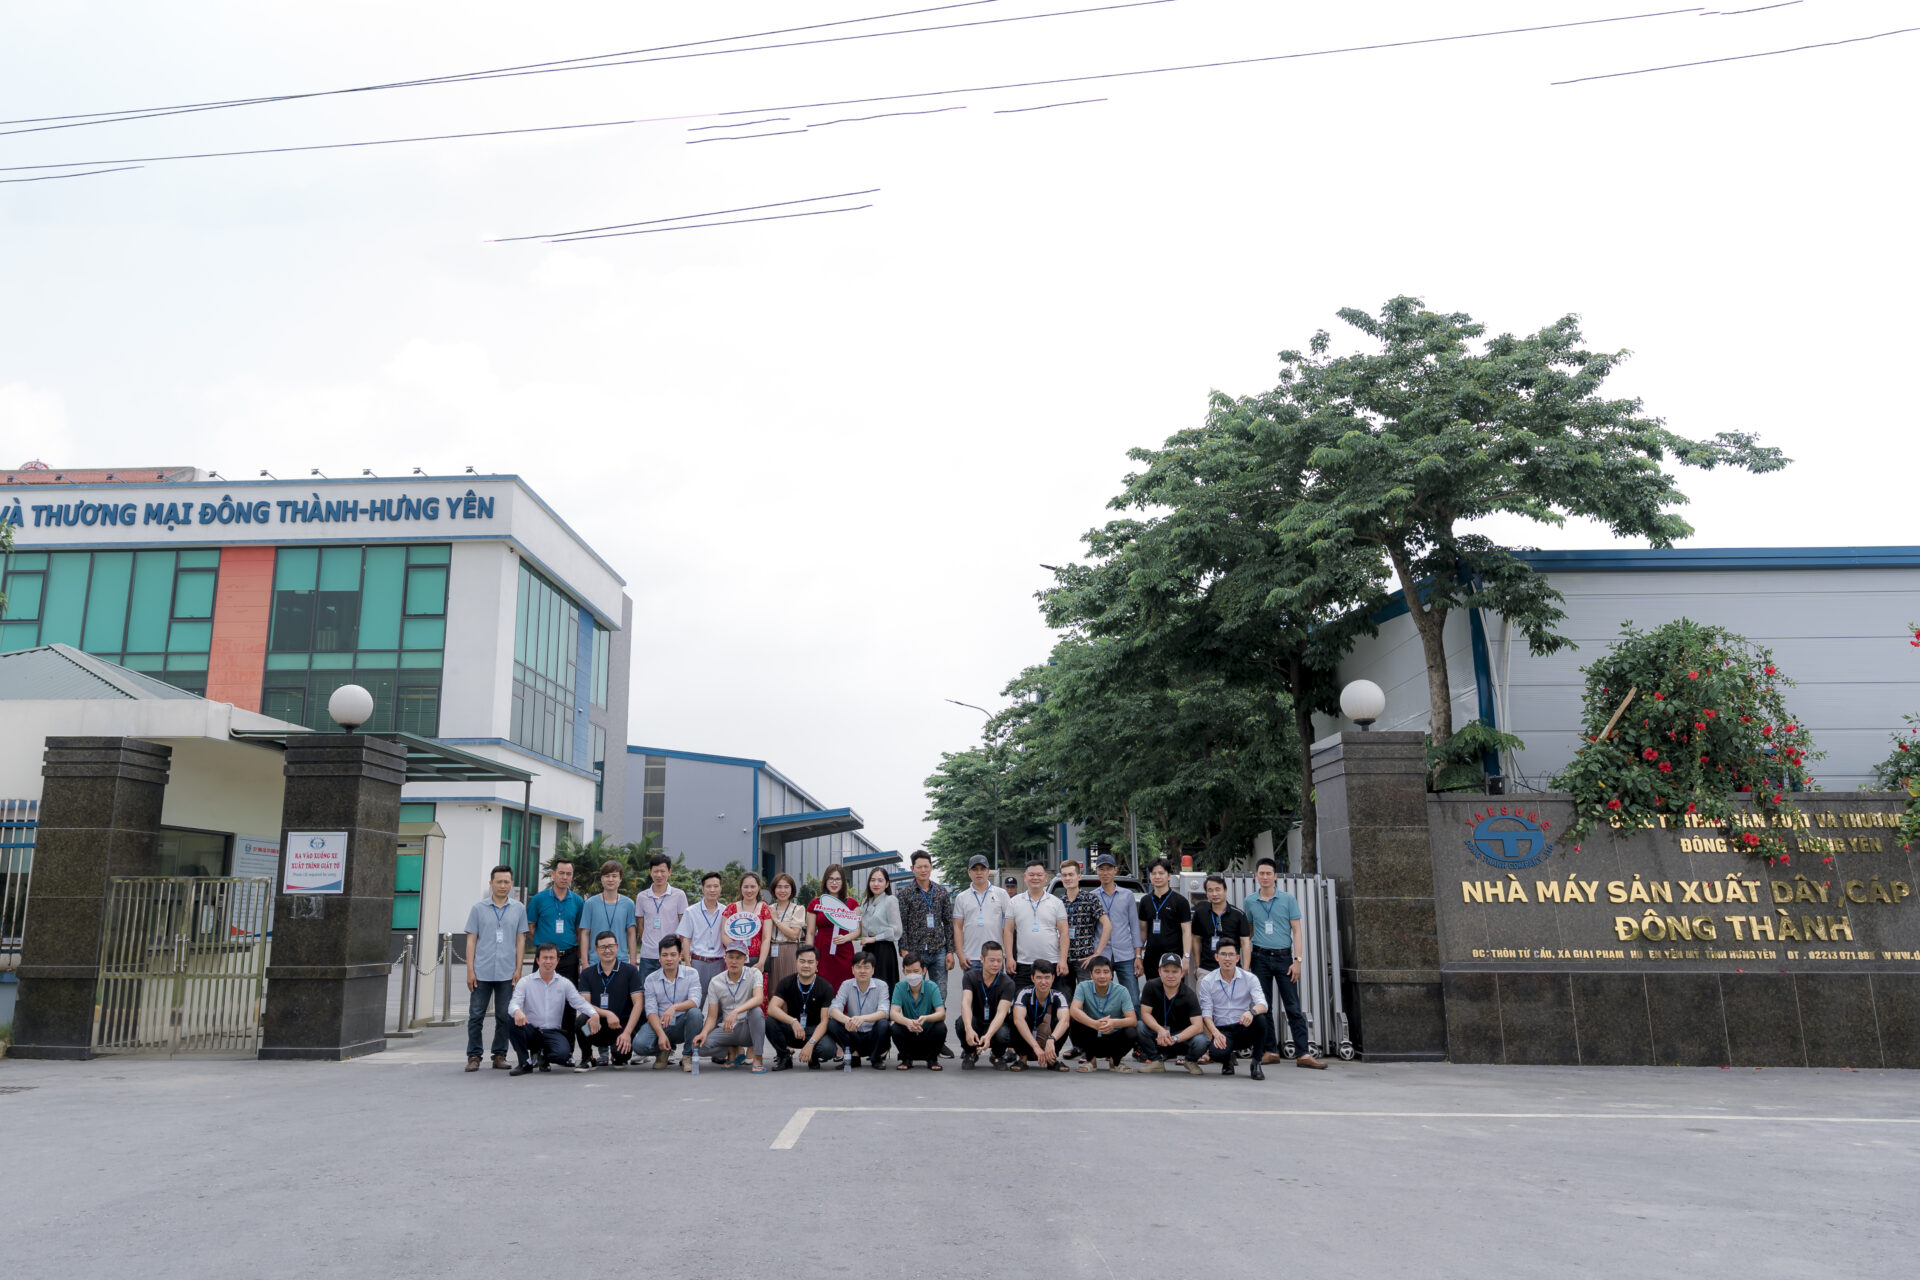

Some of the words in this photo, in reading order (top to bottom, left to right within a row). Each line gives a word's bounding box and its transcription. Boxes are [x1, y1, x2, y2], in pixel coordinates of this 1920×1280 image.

[31, 500, 137, 527] THƯƠNG
[143, 502, 193, 531] MẠI
[199, 494, 271, 524] ĐÔNG
[446, 489, 495, 519] YÊN
[1465, 806, 1551, 831] TAESUNG
[1814, 810, 1839, 828] VÀ
[1680, 834, 1727, 853] ĐÔNG
[1848, 834, 1884, 853] YÊN
[1461, 873, 1528, 903] NHÀ
[1535, 873, 1599, 903] MÁY
[1607, 873, 1673, 903] SẢN
[1678, 872, 1761, 903] XUẤT
[1614, 908, 1717, 941] ĐÔNG
[1724, 908, 1854, 941] THÀNH
[1573, 949, 1594, 959] GIAI
[1757, 949, 1777, 960] YÊN
